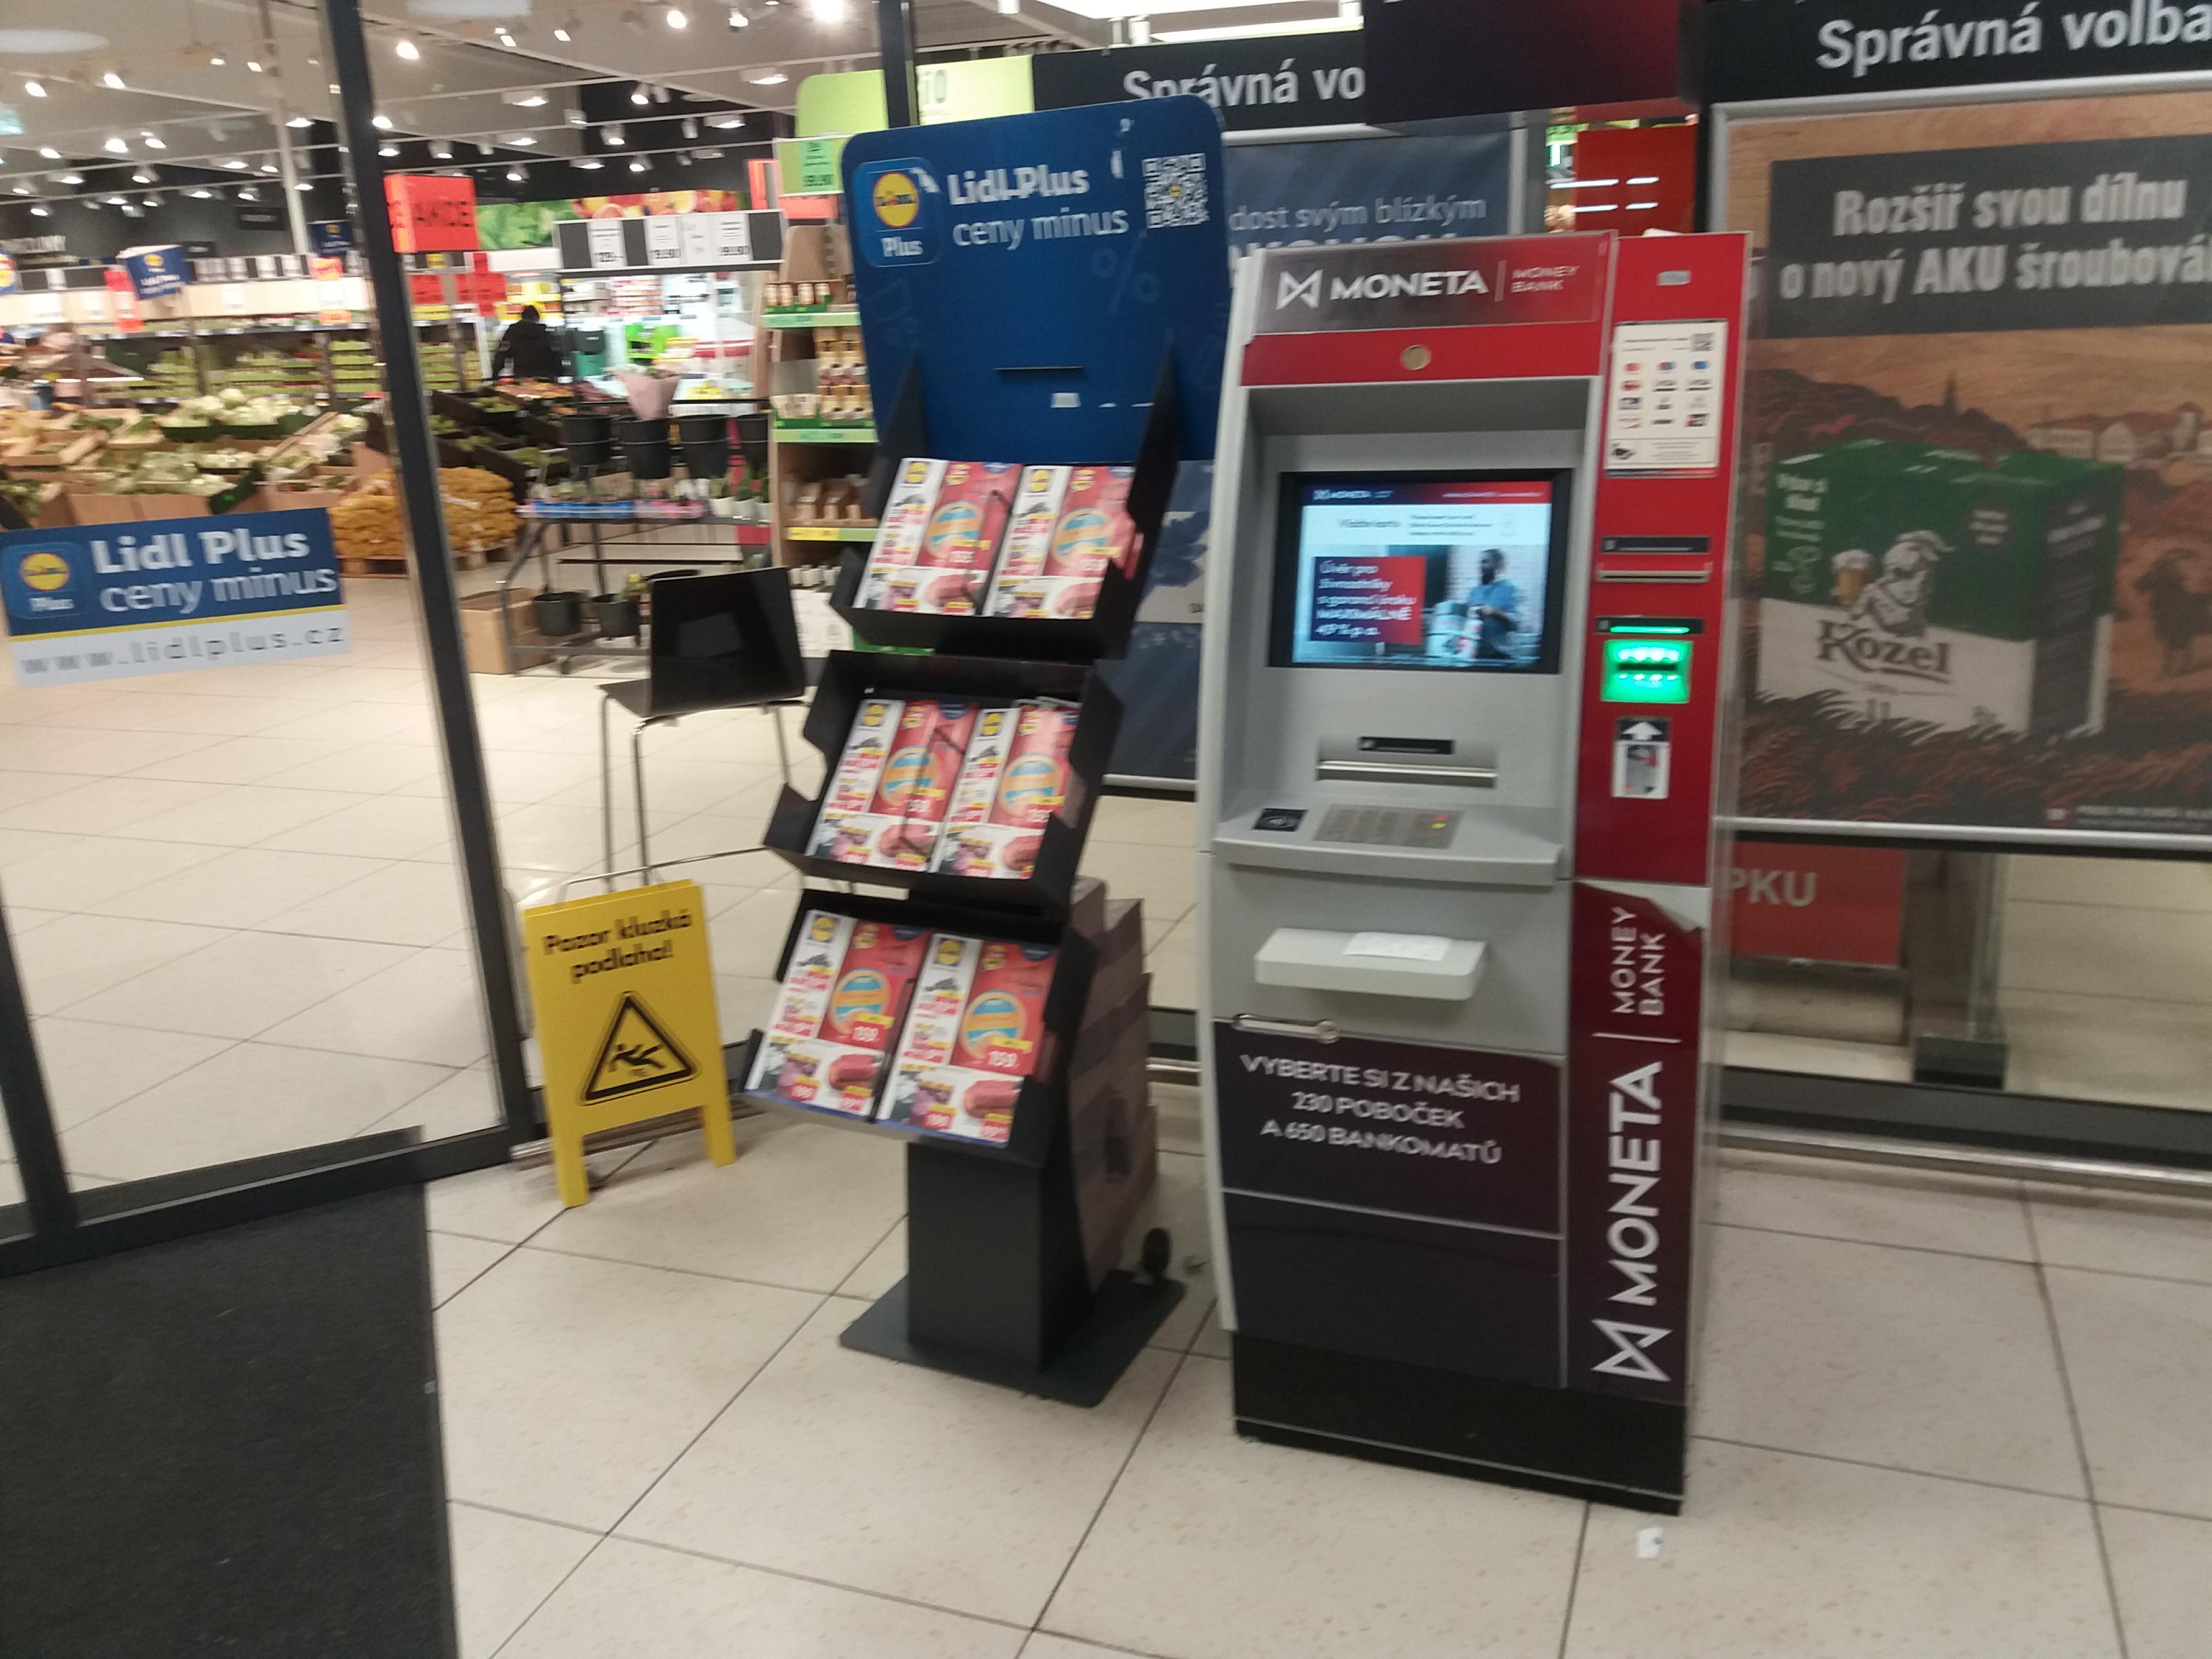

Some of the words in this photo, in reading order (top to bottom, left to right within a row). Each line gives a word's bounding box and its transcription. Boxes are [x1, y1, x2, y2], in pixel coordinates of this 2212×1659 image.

[1816, 4, 2043, 77] Správná
[2061, 0, 2212, 51] volba
[947, 170, 1012, 205] Lidl
[1015, 164, 1090, 199] Plus
[1972, 186, 2072, 228] svou
[2081, 171, 2188, 223] dílnu
[953, 220, 1024, 250] ceny
[1033, 207, 1130, 241] minus
[1295, 201, 1368, 232] svým
[1375, 194, 1487, 227] blízkým
[882, 237, 924, 257] Plus
[1779, 262, 1805, 300] o
[1811, 247, 1904, 305] nový
[1912, 245, 2009, 295] AKU
[2017, 233, 2212, 290] šroubová
[1330, 270, 1490, 301] MONETA
[89, 533, 193, 574] Lidl
[198, 527, 311, 565] Plus
[100, 579, 203, 614] ceny
[209, 567, 337, 602] minus
[20, 626, 345, 674] www.lidlplus.cz
[1817, 619, 1953, 682] Kozel
[542, 930, 612, 956] Pozor
[1611, 905, 1637, 1014] MONEY
[1638, 932, 1666, 1017] BANK
[1240, 1054, 1361, 1086] VYBERTE
[1364, 1068, 1389, 1088] SI
[1391, 1071, 1411, 1092] Z
[1414, 1073, 1521, 1103] NAŠICH
[1336, 1096, 1465, 1129] POBOČEK
[1261, 1119, 1282, 1138] A
[1328, 1126, 1502, 1164] BANKOMATŮ
[1607, 1061, 1663, 1307] MONETA
